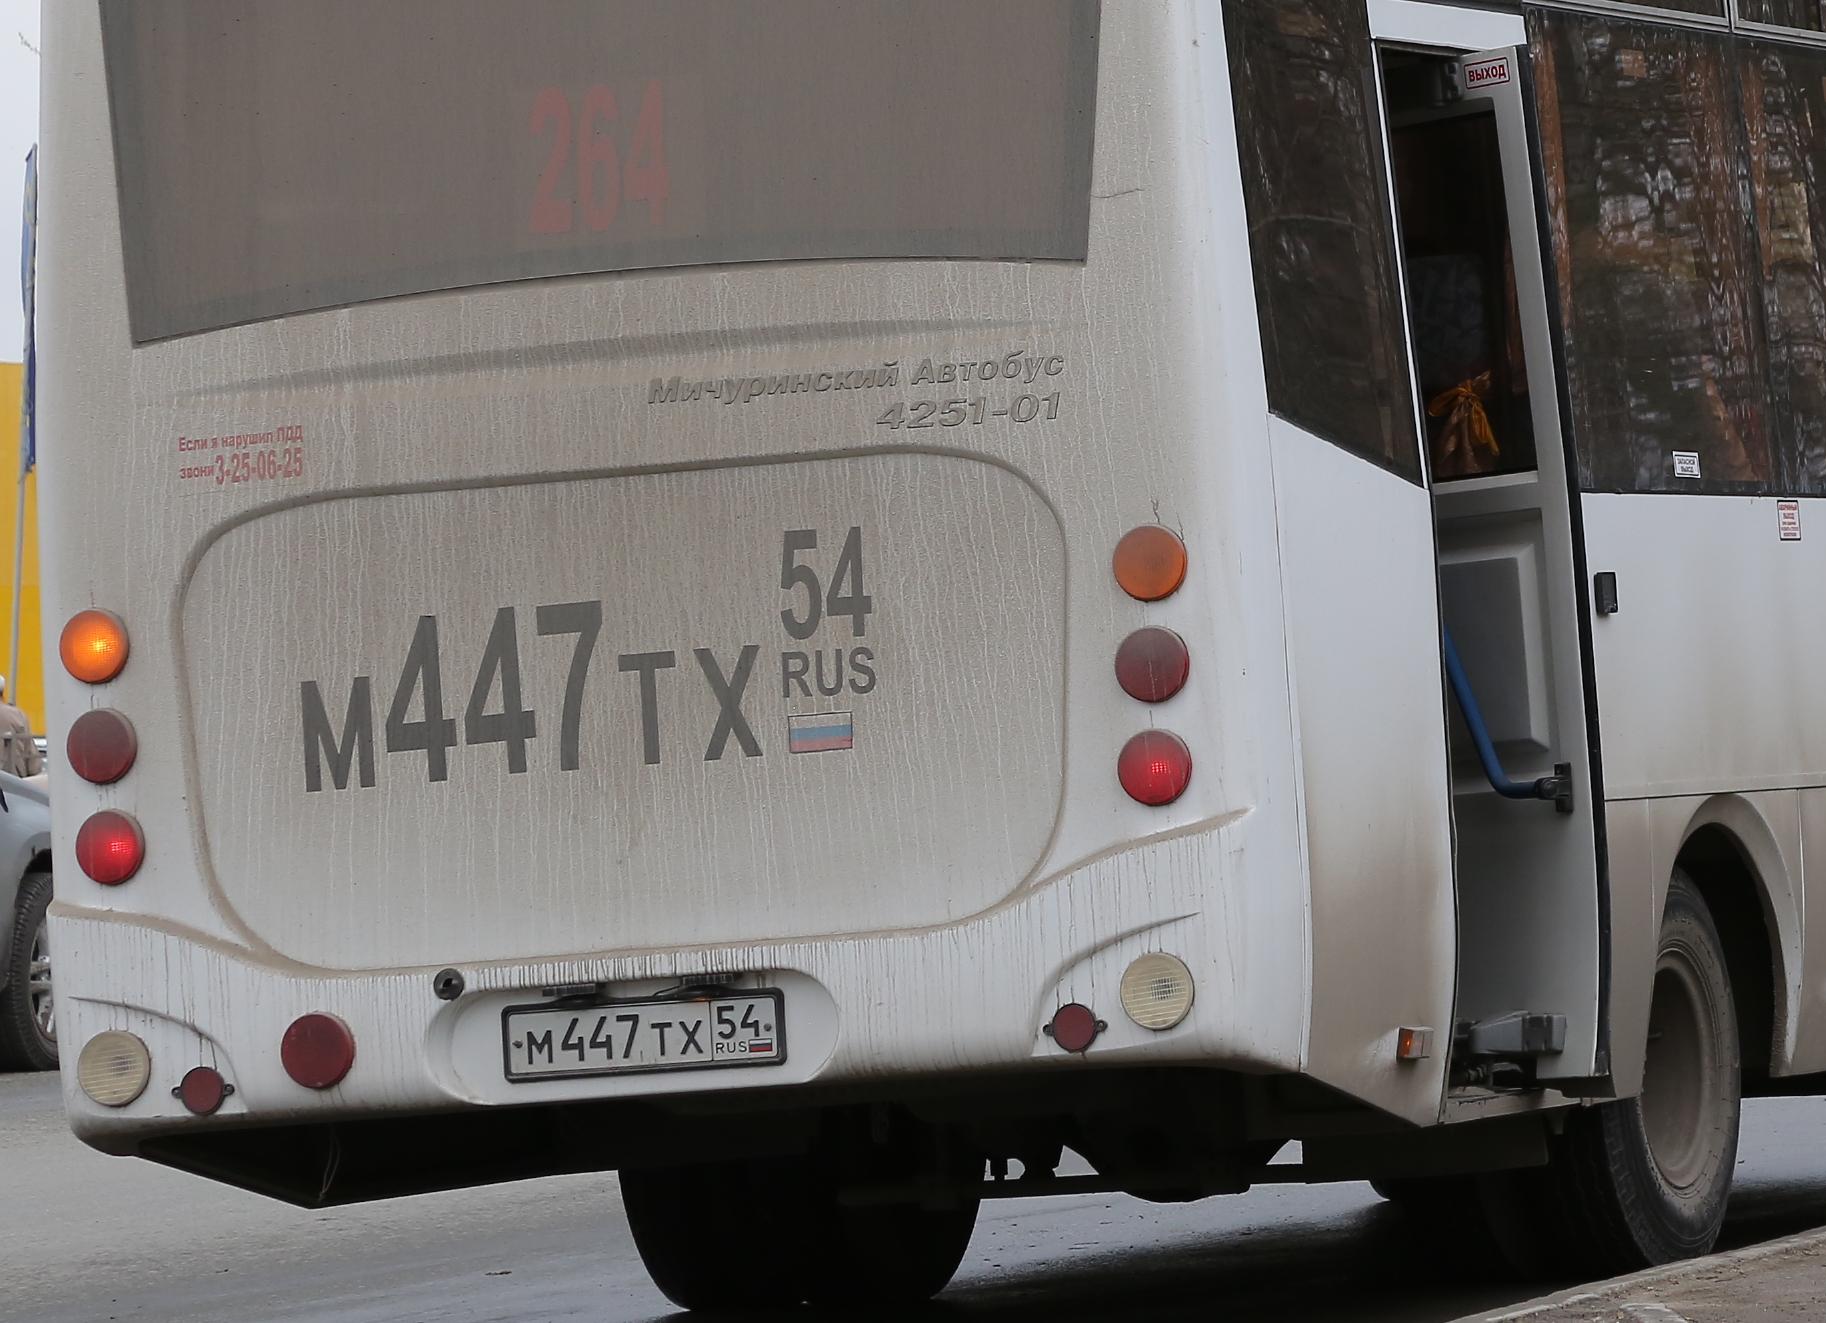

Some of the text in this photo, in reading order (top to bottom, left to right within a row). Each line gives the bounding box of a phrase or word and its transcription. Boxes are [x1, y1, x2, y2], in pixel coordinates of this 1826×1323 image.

[1468, 65, 1507, 82] ВЫХОД
[529, 81, 670, 236] 264
[647, 350, 1065, 405] Мичуринский Автобус
[876, 392, 1063, 430] 4251-01
[179, 425, 303, 452] Если я нарушил ПДД
[179, 447, 304, 485] звони 3-25-06-25
[779, 526, 873, 640] 54
[782, 643, 877, 698] RUS
[716, 1004, 760, 1039] 54
[715, 1042, 748, 1054] RUS
